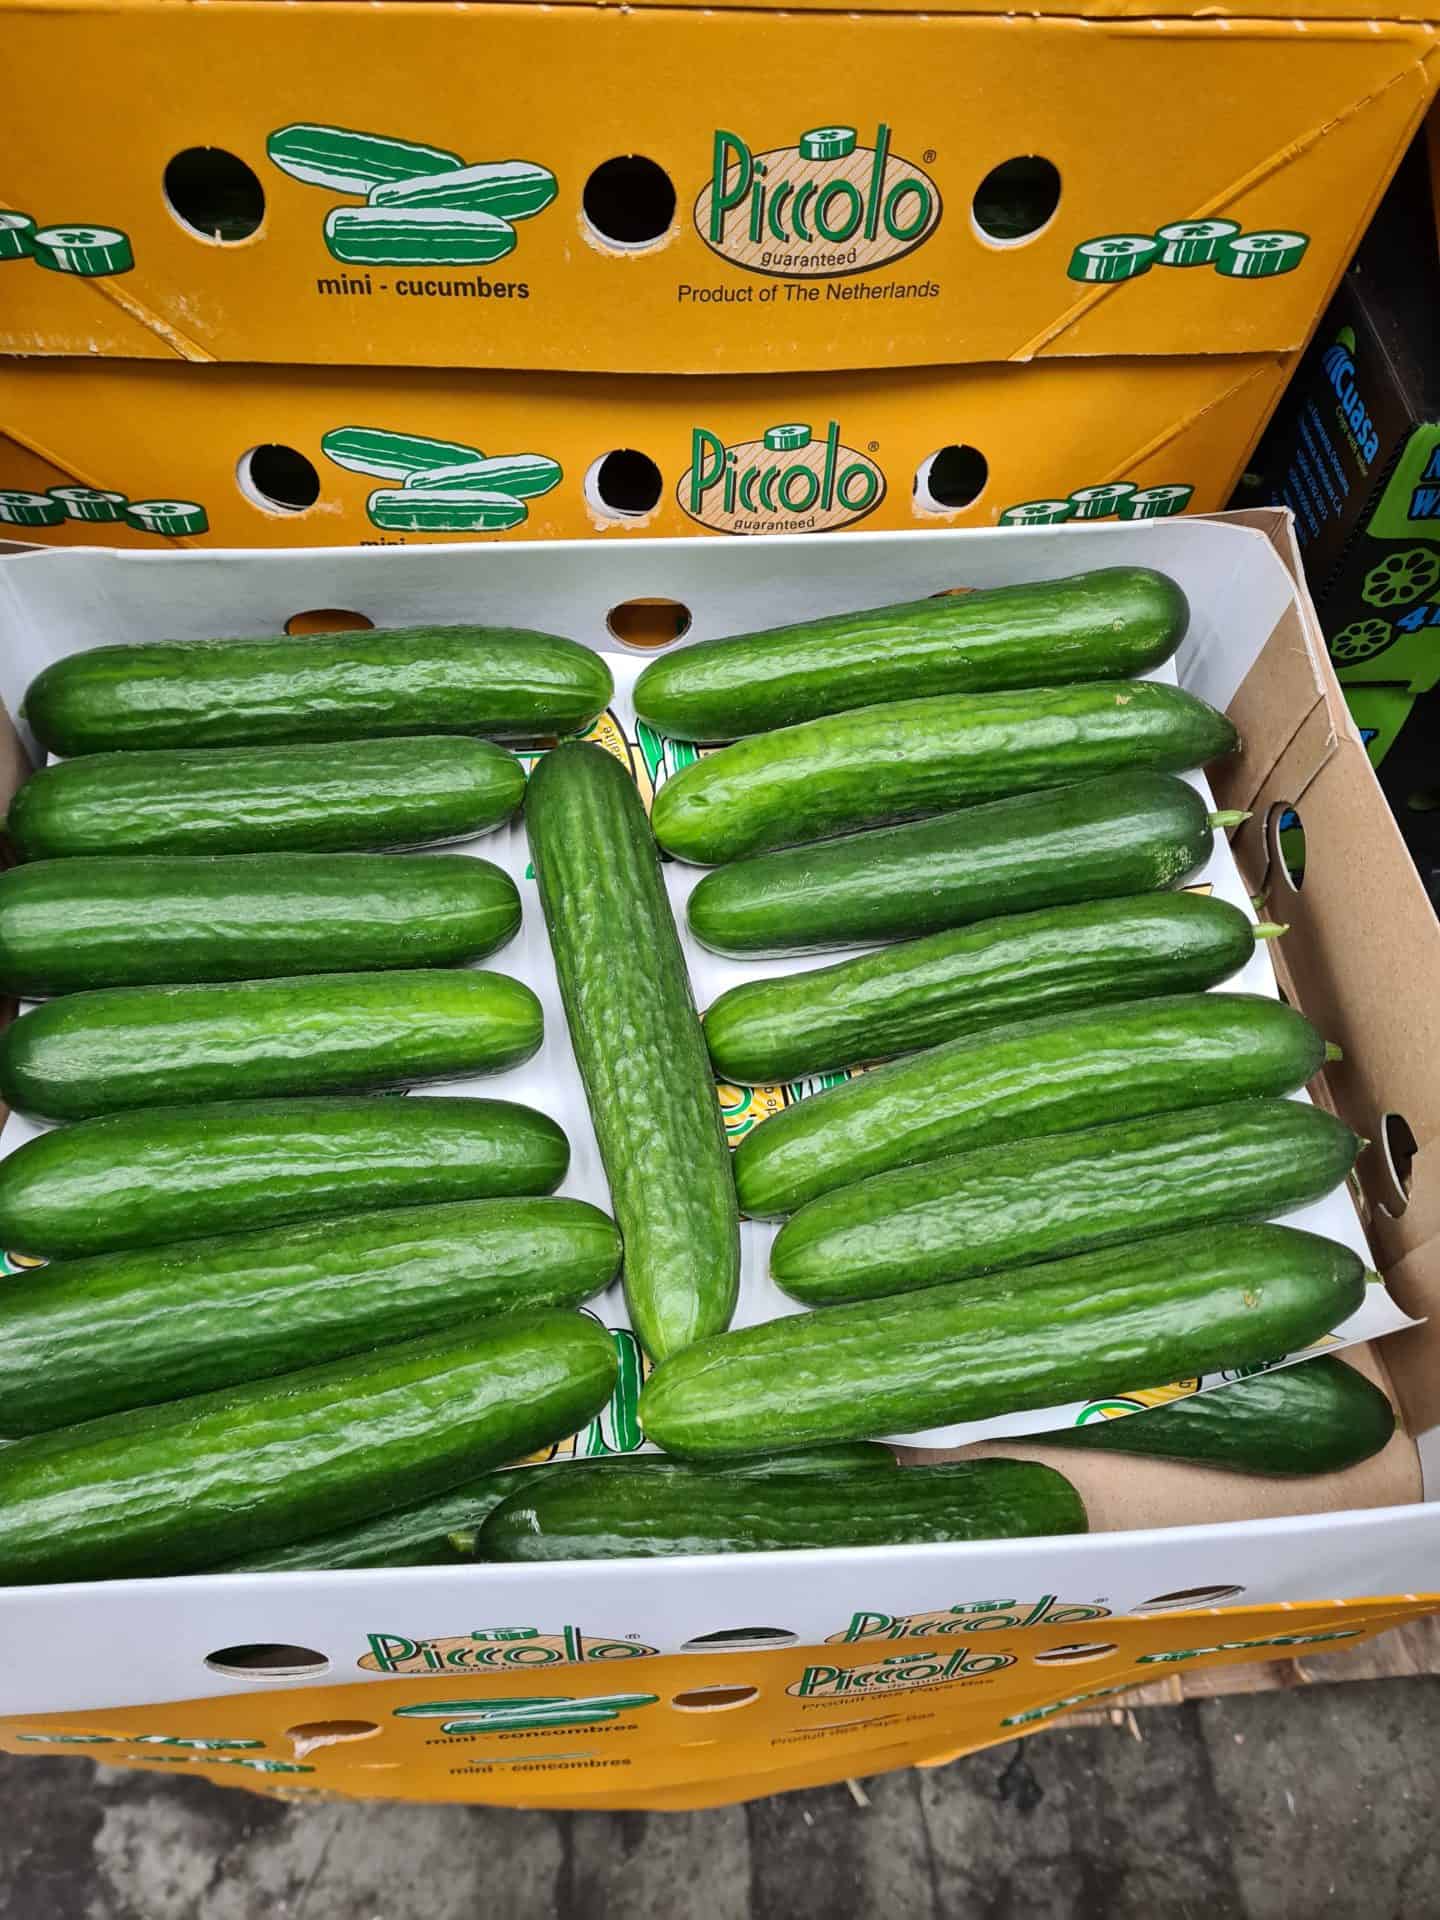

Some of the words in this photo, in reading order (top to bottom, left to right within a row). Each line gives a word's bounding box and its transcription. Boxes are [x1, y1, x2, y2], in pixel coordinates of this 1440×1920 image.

[710, 123, 934, 243] Piccolo
[761, 248, 857, 268] guaranteed
[317, 273, 372, 295] mini
[395, 276, 530, 299] cucumbers
[677, 284, 754, 302] Product
[759, 284, 778, 302] of
[784, 283, 821, 301] The
[826, 280, 941, 300] Netherlands
[690, 420, 878, 514] Piccolo
[733, 516, 816, 531] guaranteed
[842, 1594, 1103, 1643] Piccolo
[367, 1624, 645, 1672] Piccolo
[798, 1647, 1013, 1696] Piccolo
[425, 1735, 477, 1745] mini
[498, 1723, 639, 1741] concombres
